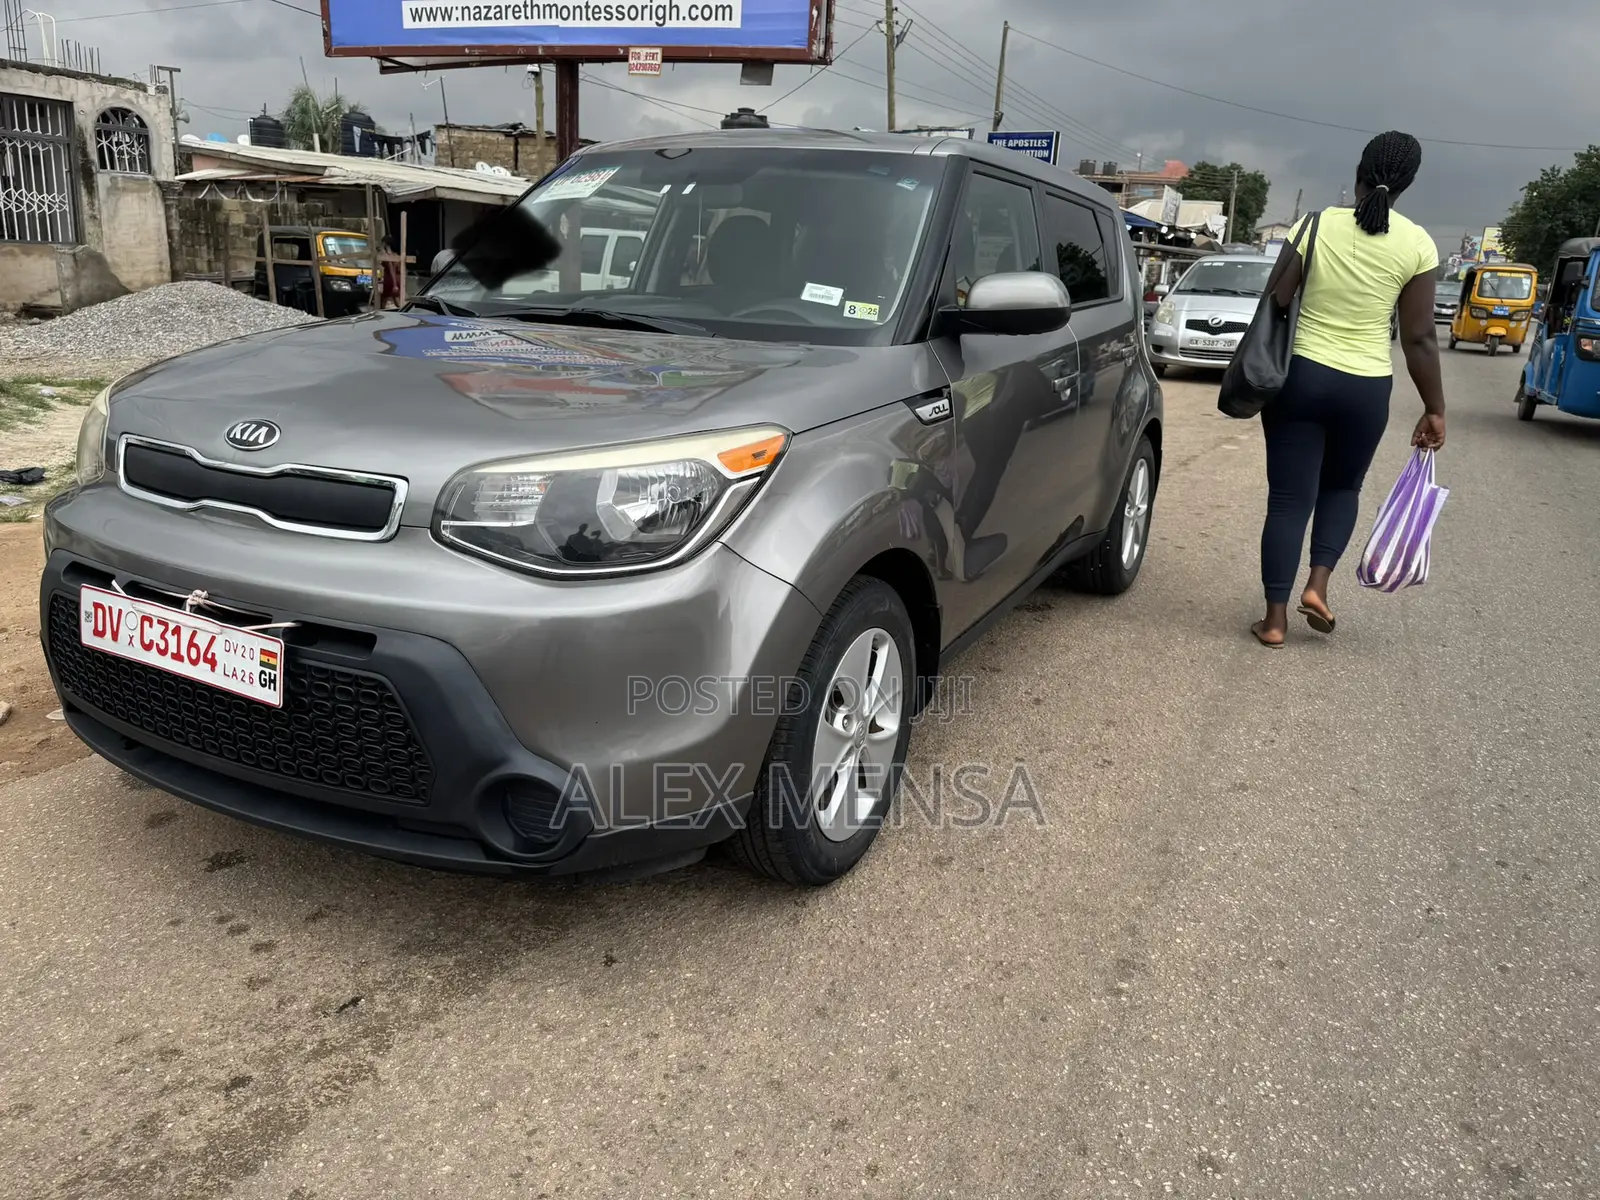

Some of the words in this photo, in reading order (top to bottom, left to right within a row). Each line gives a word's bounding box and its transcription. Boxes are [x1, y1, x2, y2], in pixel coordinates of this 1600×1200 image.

[992, 139, 1007, 147] THE
[848, 305, 856, 315] 8
[867, 307, 878, 316] 25
[229, 422, 269, 444] KIA
[93, 601, 123, 643] DV
[139, 614, 218, 673] C3164
[224, 638, 255, 661] DV20
[223, 662, 254, 685] LA26
[258, 669, 277, 692] GH
